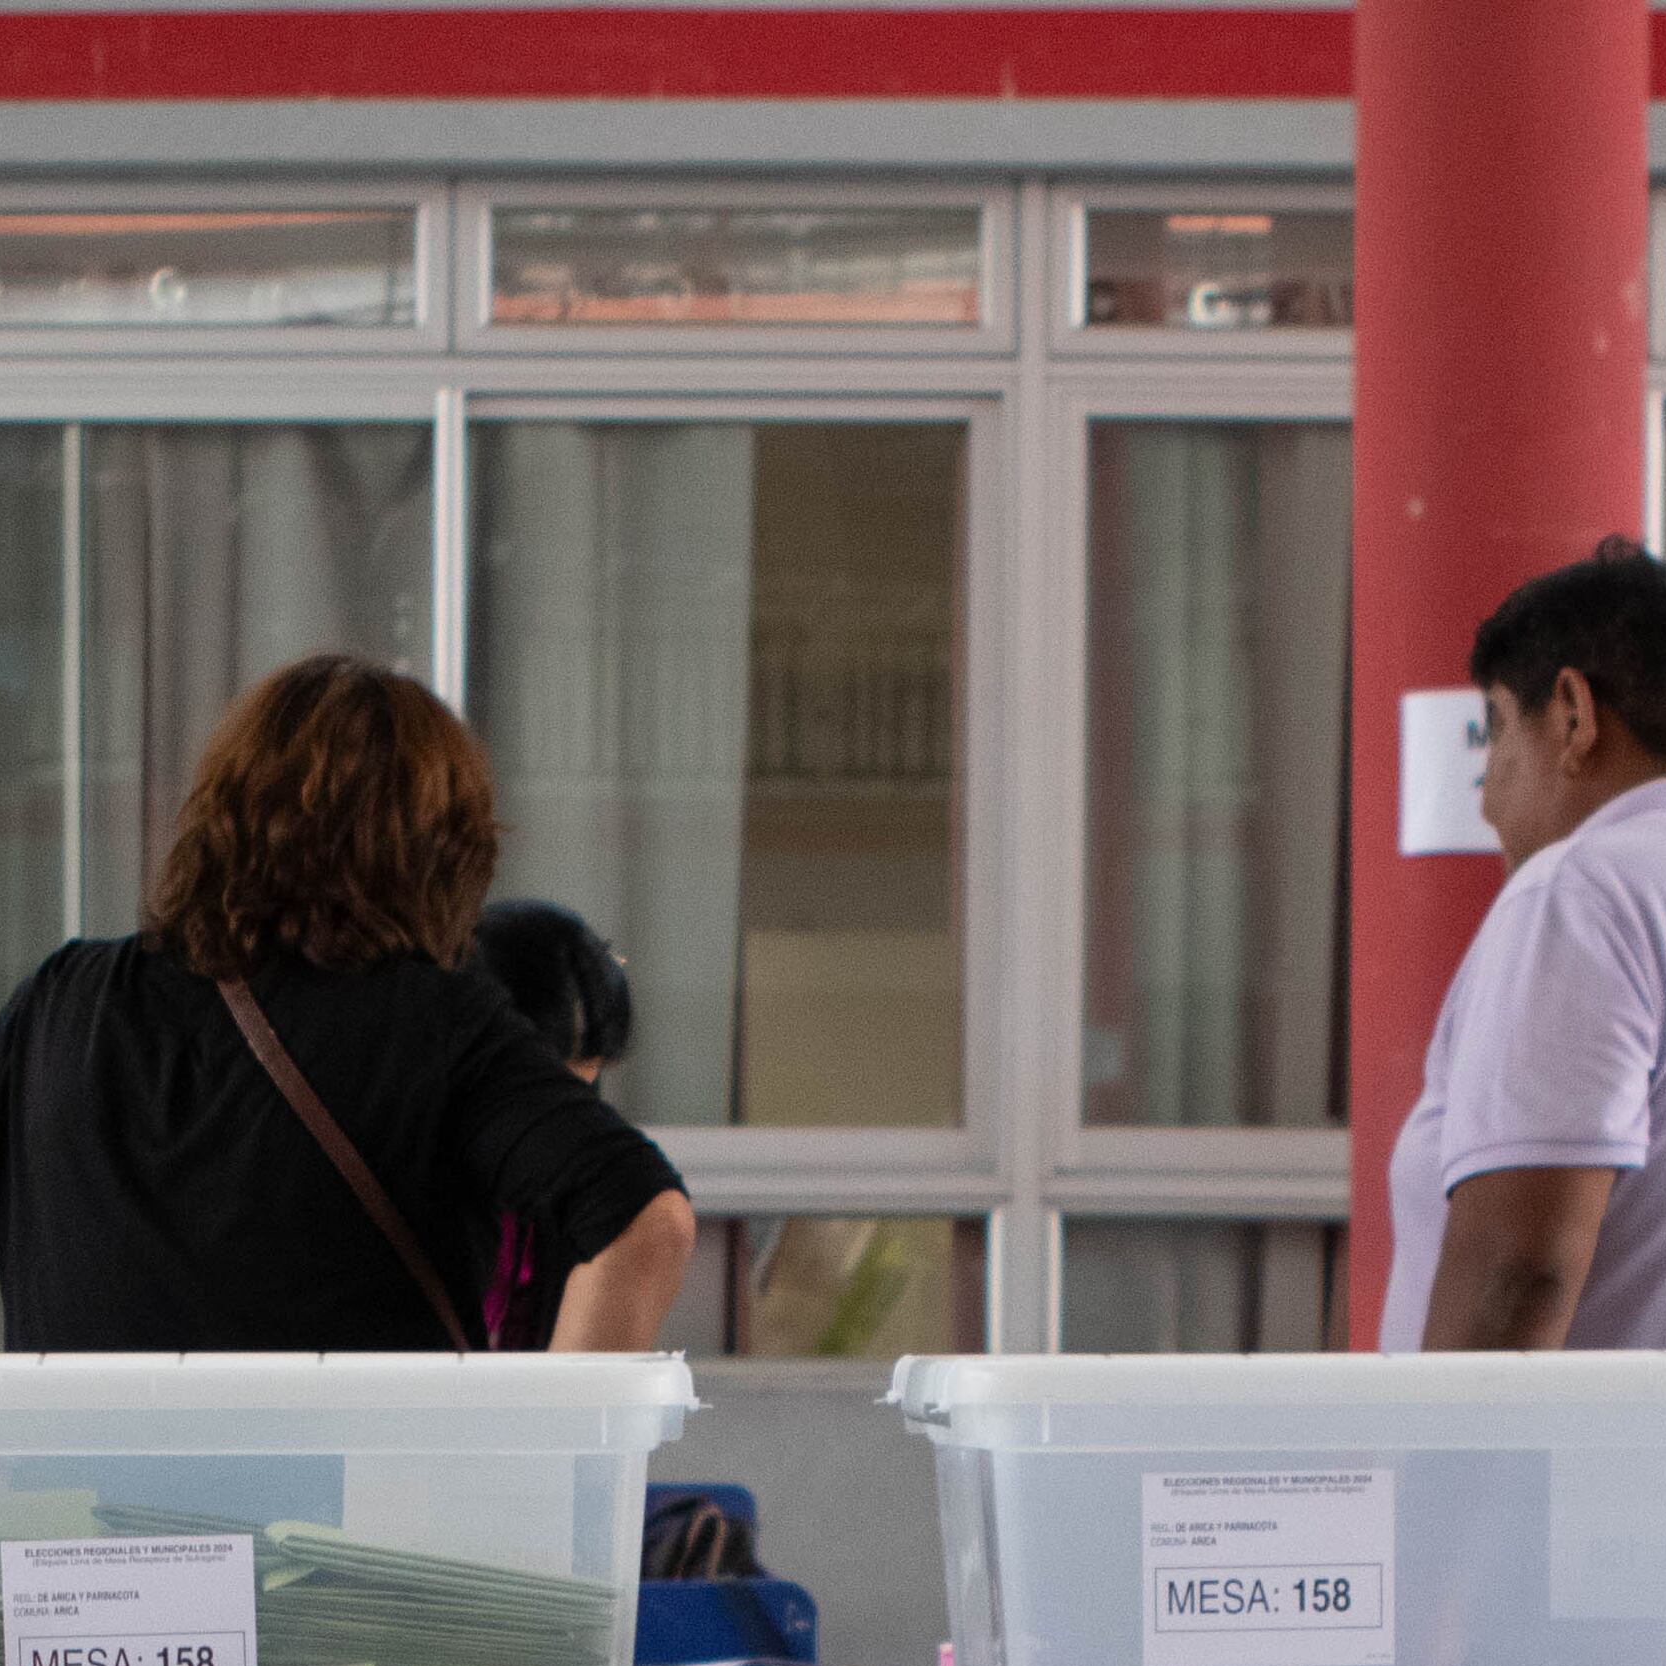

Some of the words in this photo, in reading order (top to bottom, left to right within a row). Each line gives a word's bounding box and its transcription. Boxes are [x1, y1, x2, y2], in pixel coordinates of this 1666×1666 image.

[24, 1548, 82, 1558] ELECCIONES
[83, 1546, 141, 1556] REGIONALES
[151, 1544, 211, 1554] MUNICIPALES
[37, 1593, 48, 1603] DE
[51, 1592, 76, 1602] ARICA
[86, 1590, 140, 1601] PARINACOTA
[1167, 1578, 1280, 1614] MESA:
[1293, 1577, 1351, 1613] 158
[54, 1606, 79, 1616] ARICA
